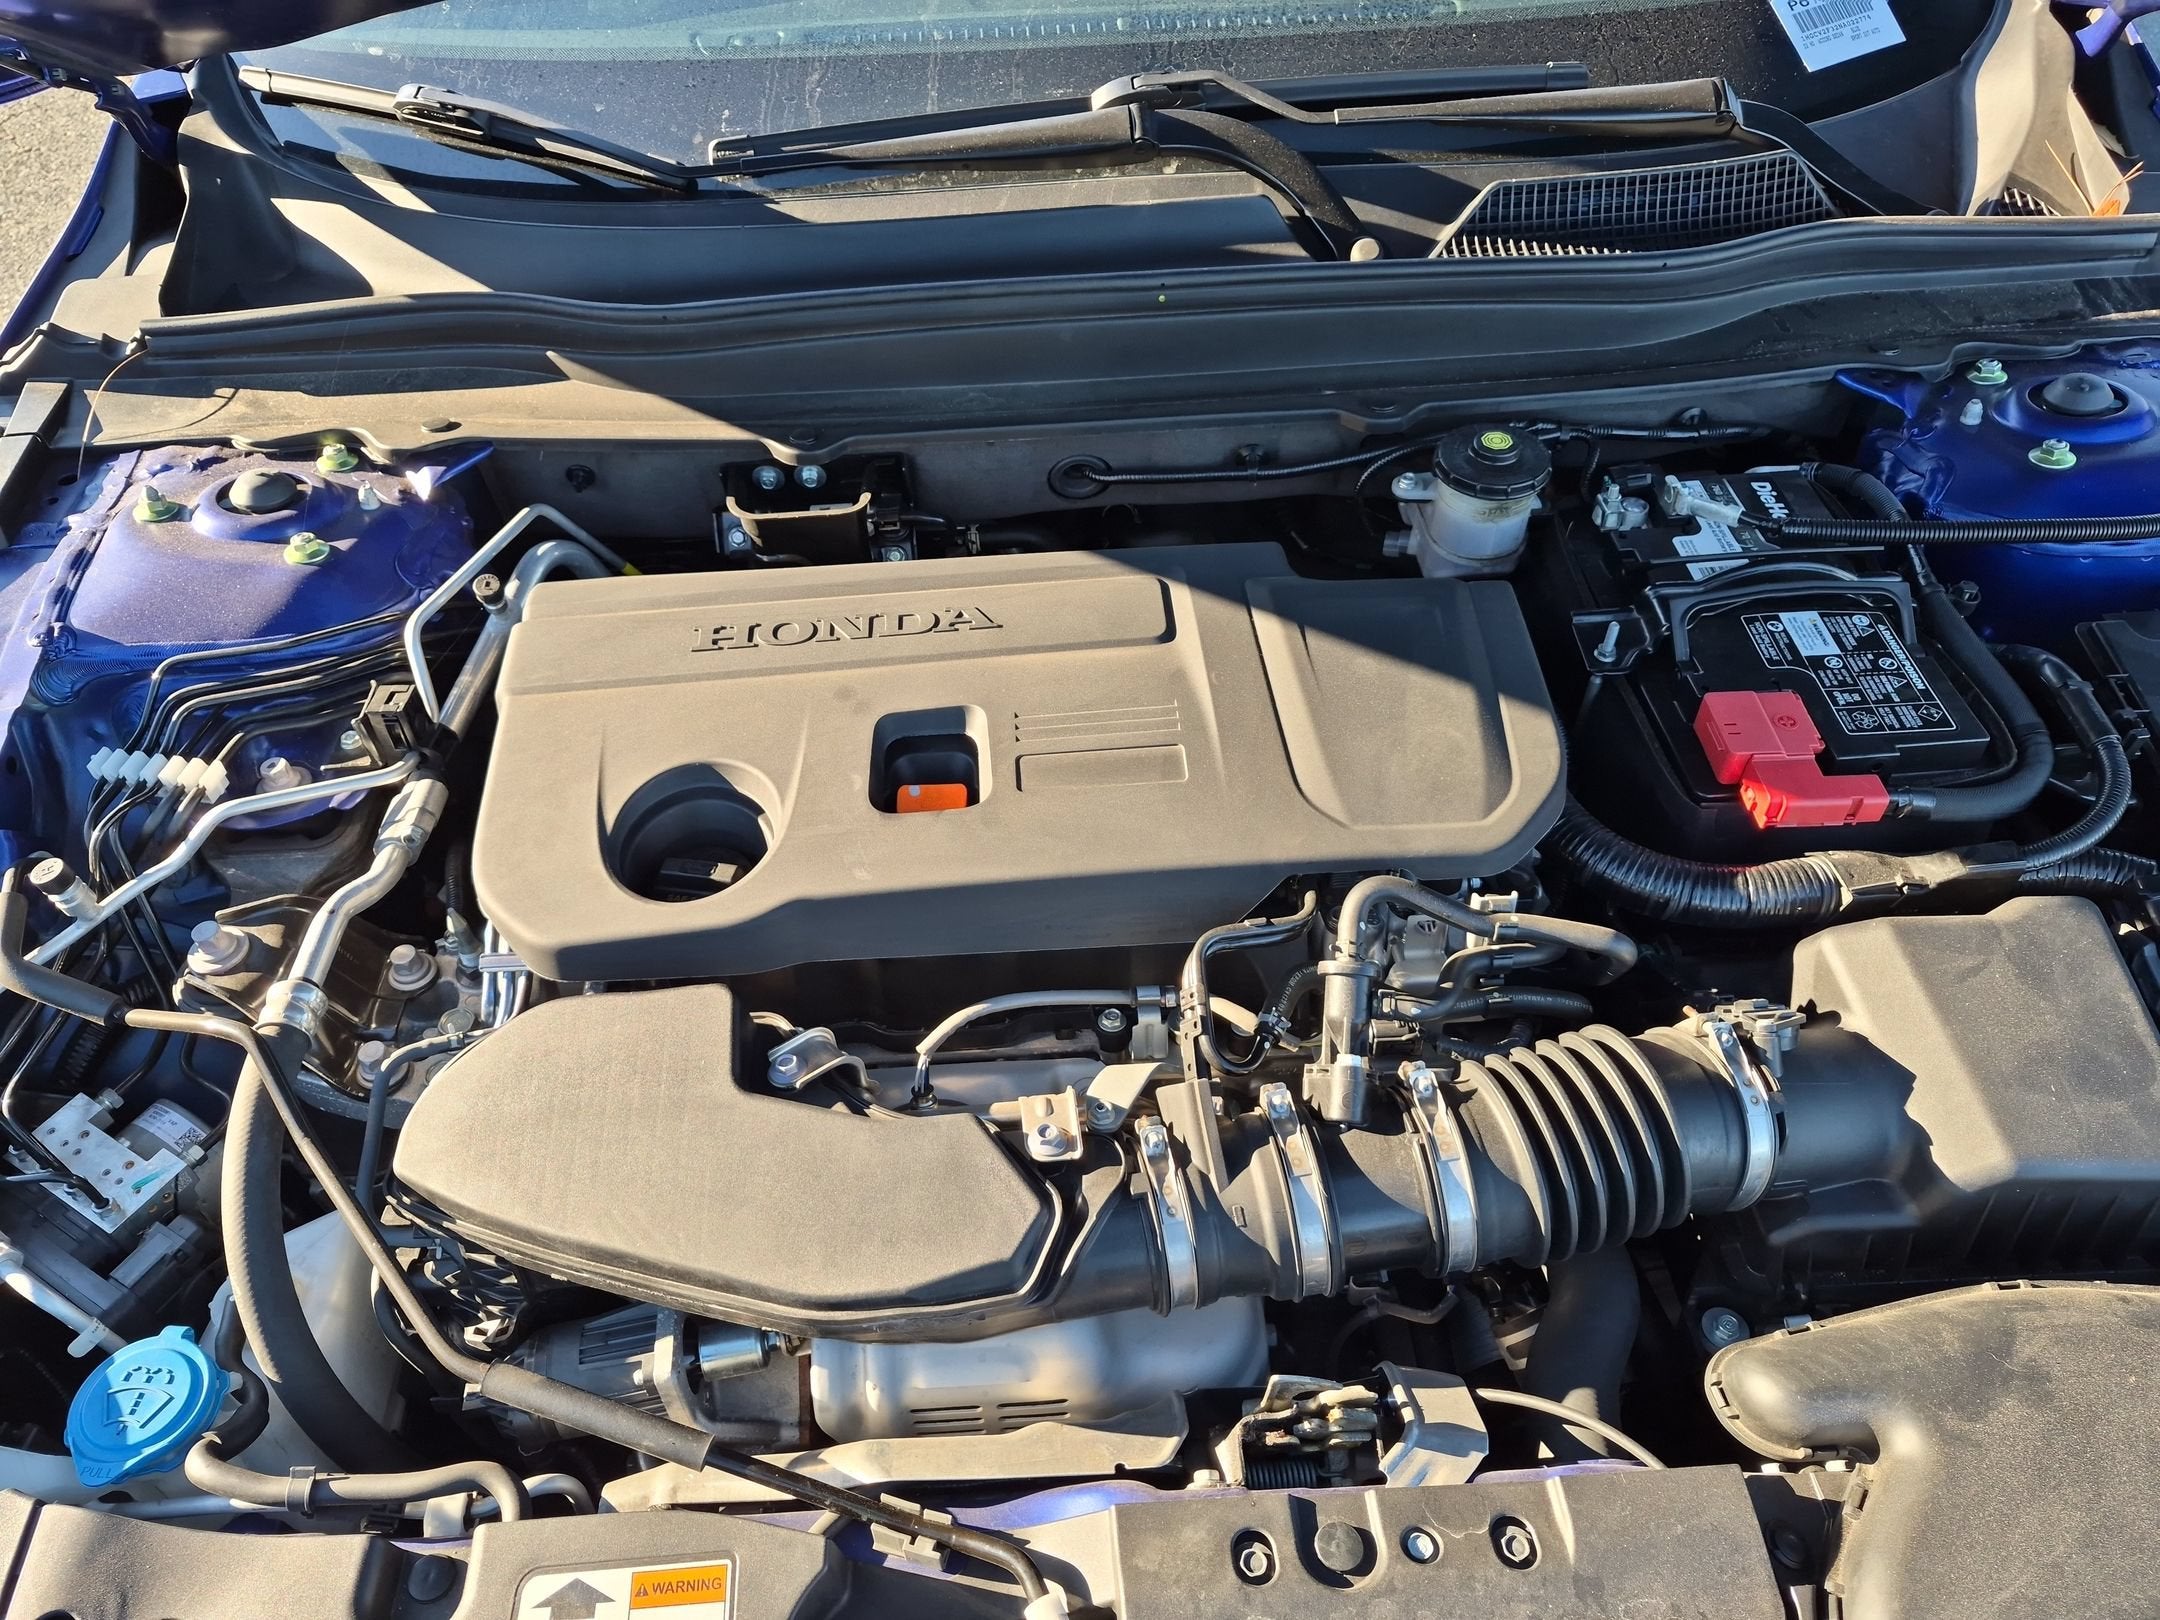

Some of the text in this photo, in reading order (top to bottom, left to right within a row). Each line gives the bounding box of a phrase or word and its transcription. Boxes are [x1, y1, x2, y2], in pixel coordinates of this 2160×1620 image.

[691, 607, 1004, 652] HONDA
[1880, 630, 1927, 689] DANGER/POISON
[80, 1465, 113, 1479] PULL
[652, 1577, 722, 1596] WARNING
